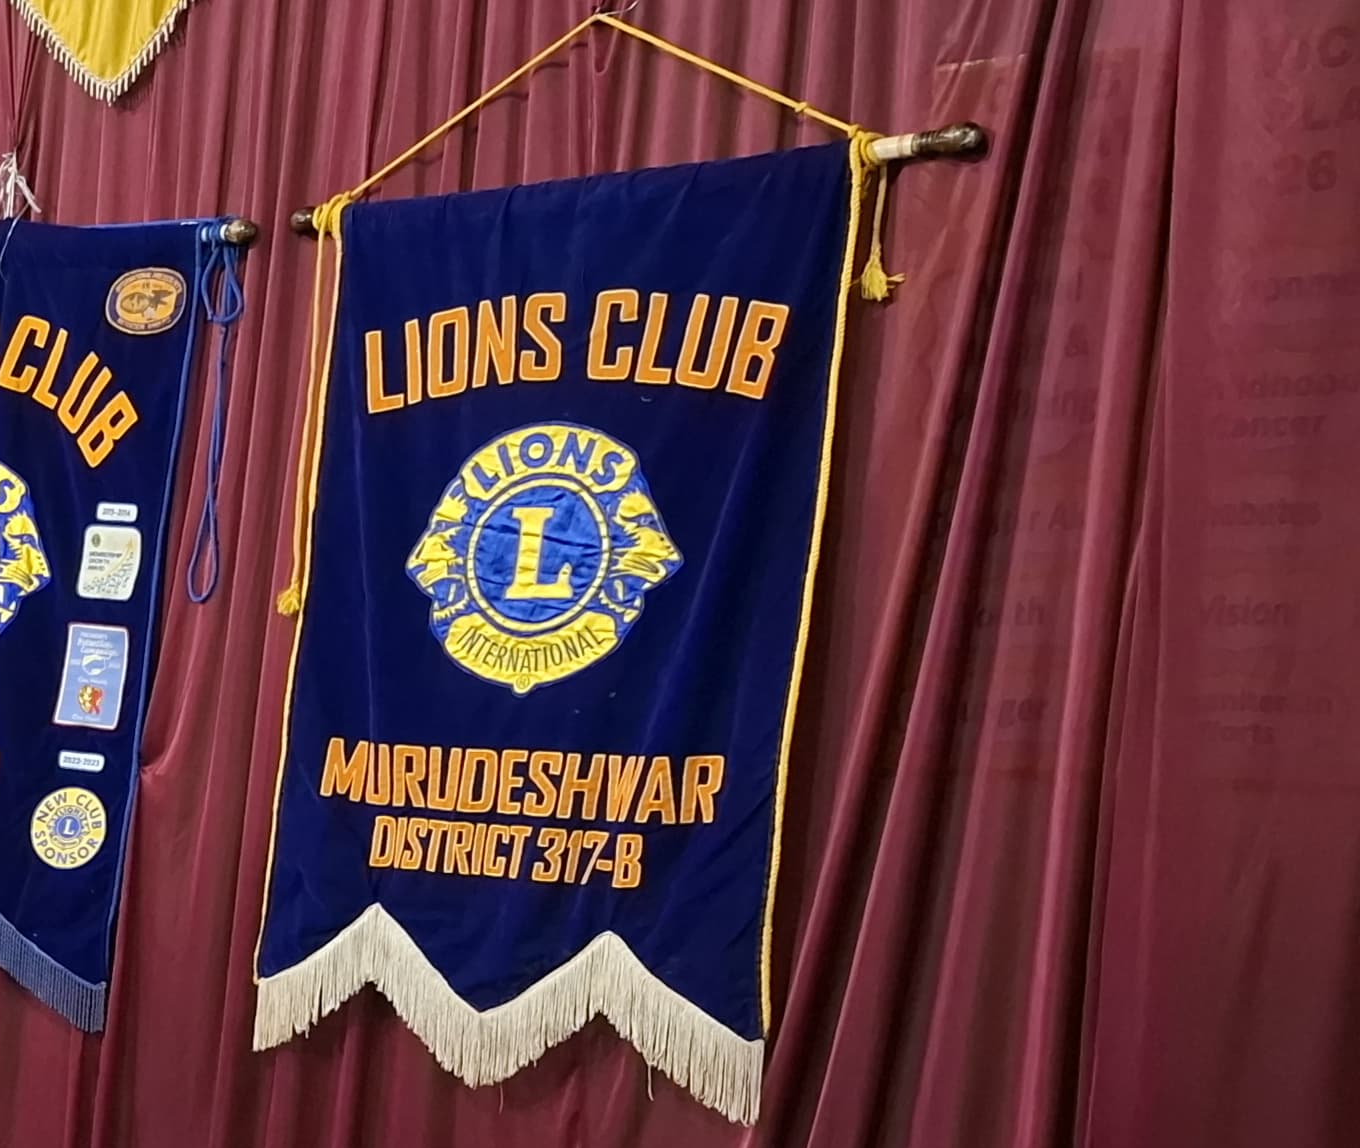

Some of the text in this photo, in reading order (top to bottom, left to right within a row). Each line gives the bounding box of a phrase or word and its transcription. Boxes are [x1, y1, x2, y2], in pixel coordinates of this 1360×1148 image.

[365, 289, 789, 414] LIONS CLUB
[471, 432, 624, 493] LIONS
[504, 507, 573, 598] L
[458, 626, 605, 673] INTERNATIONAL
[36, 792, 102, 829] NEW CLUB
[320, 738, 725, 825] MURUDESHWAR
[35, 830, 98, 864] SPONSOR
[63, 820, 75, 835] L
[369, 816, 643, 889] DISTRICT 317-B
